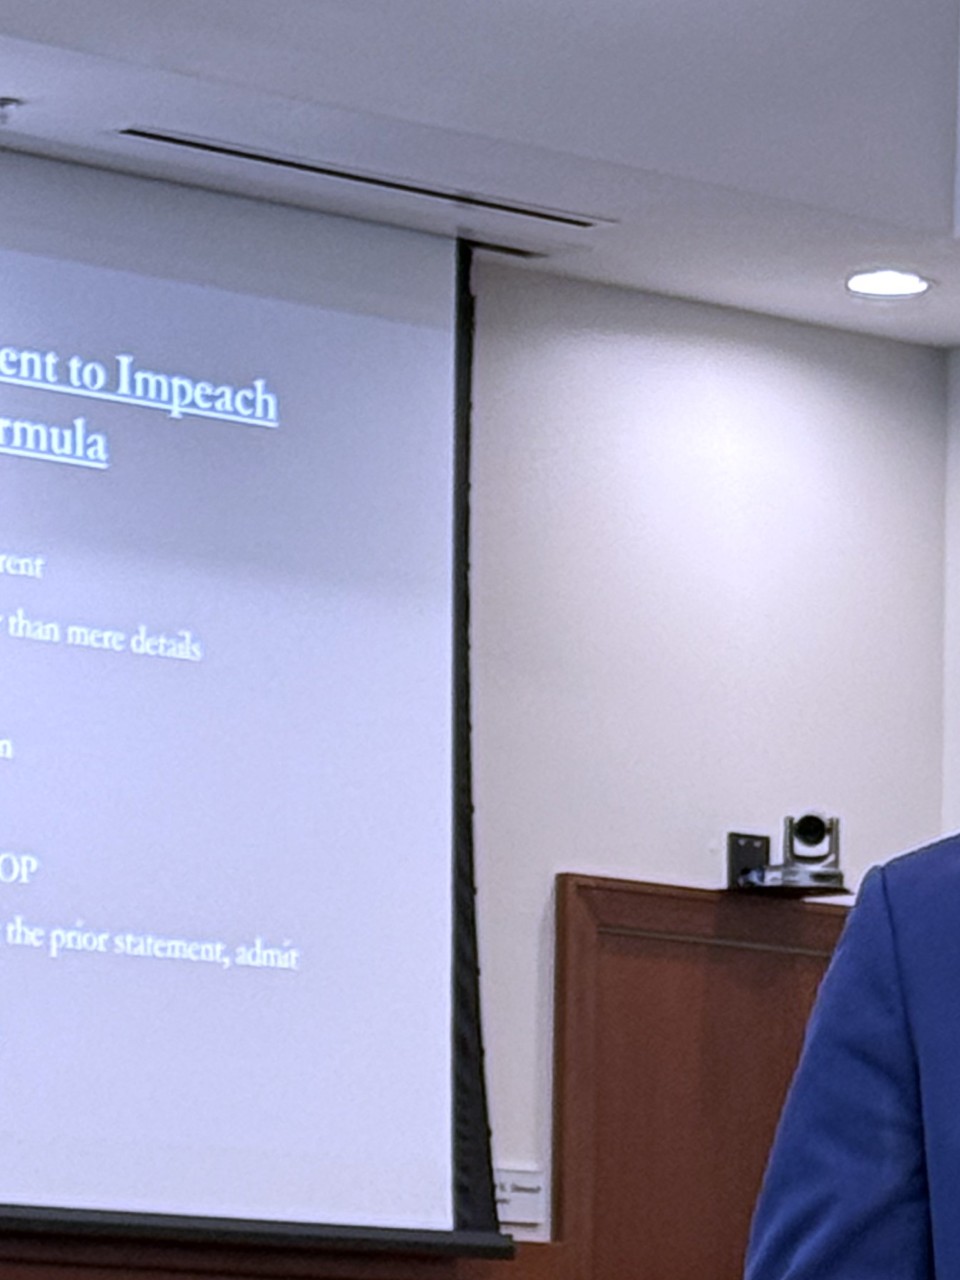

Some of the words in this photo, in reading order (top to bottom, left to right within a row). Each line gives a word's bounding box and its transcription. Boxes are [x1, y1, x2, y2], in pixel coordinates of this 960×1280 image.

[68, 355, 106, 391] to
[115, 353, 279, 420] Impeach
[8, 608, 60, 643] than
[67, 624, 126, 651] mere
[130, 625, 202, 662] details
[6, 916, 45, 947] the
[50, 919, 110, 957] prior
[114, 933, 231, 969] statement,
[235, 936, 299, 970] admit
